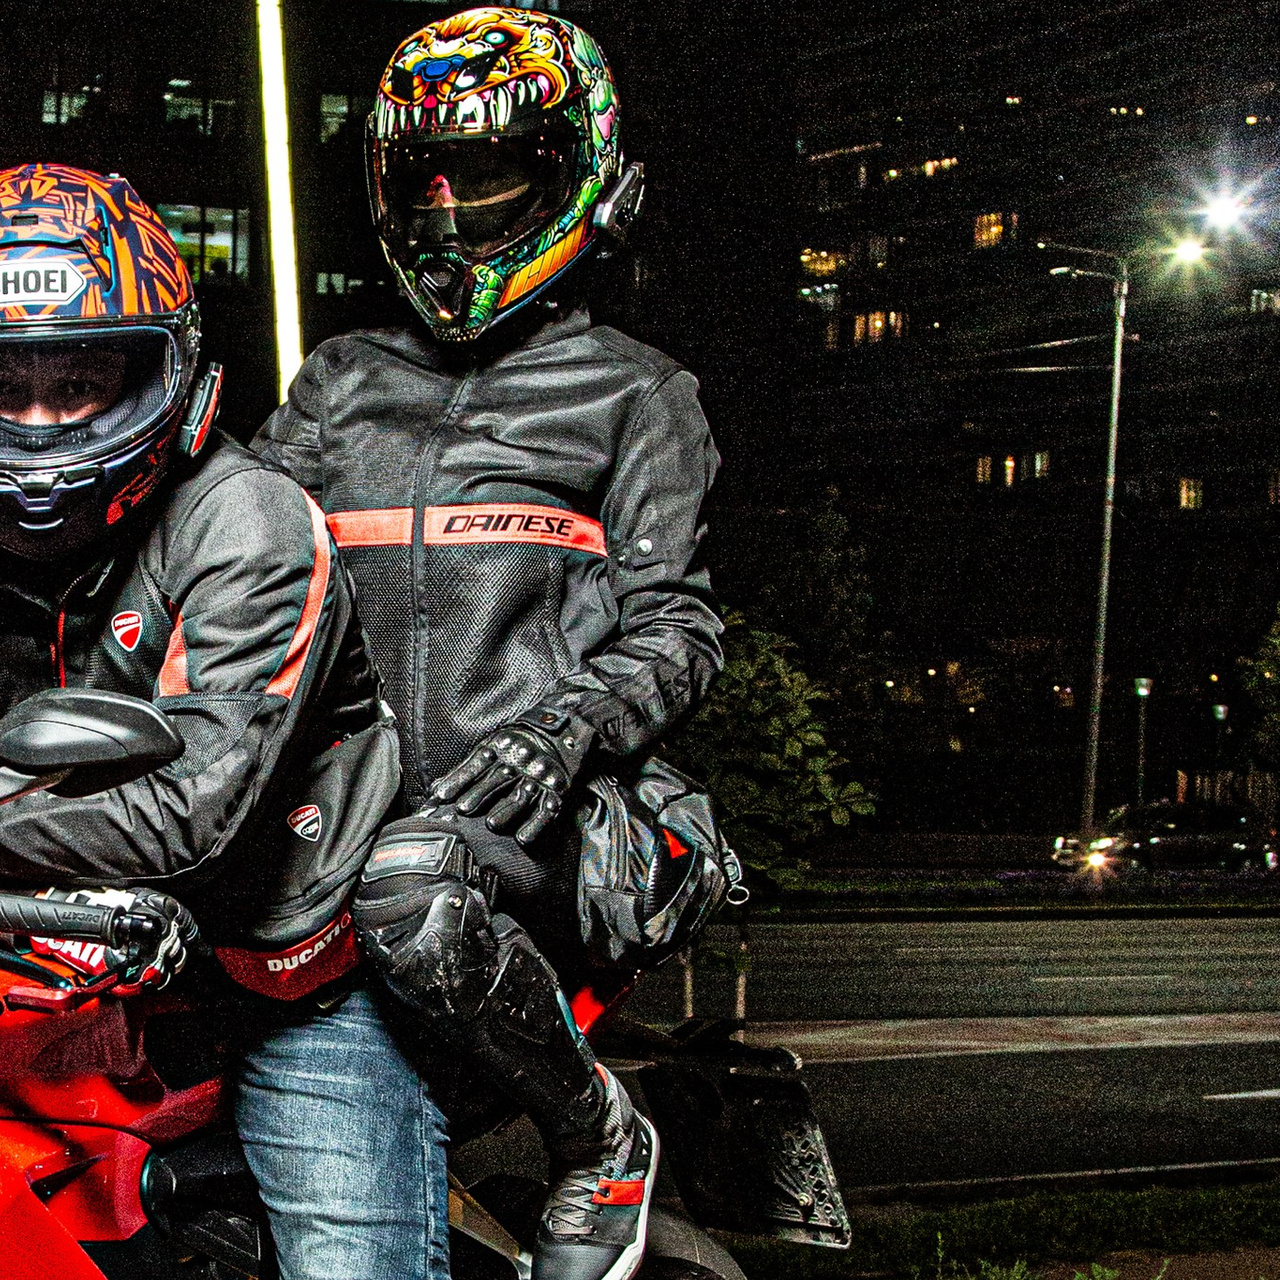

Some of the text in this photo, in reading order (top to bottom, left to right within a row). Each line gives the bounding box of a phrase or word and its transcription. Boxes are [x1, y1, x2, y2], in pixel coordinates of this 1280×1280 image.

[443, 514, 574, 536] DAINESE
[290, 807, 317, 824] DUCATI
[61, 910, 102, 923] DUCATI
[267, 923, 341, 972] DUCATI
